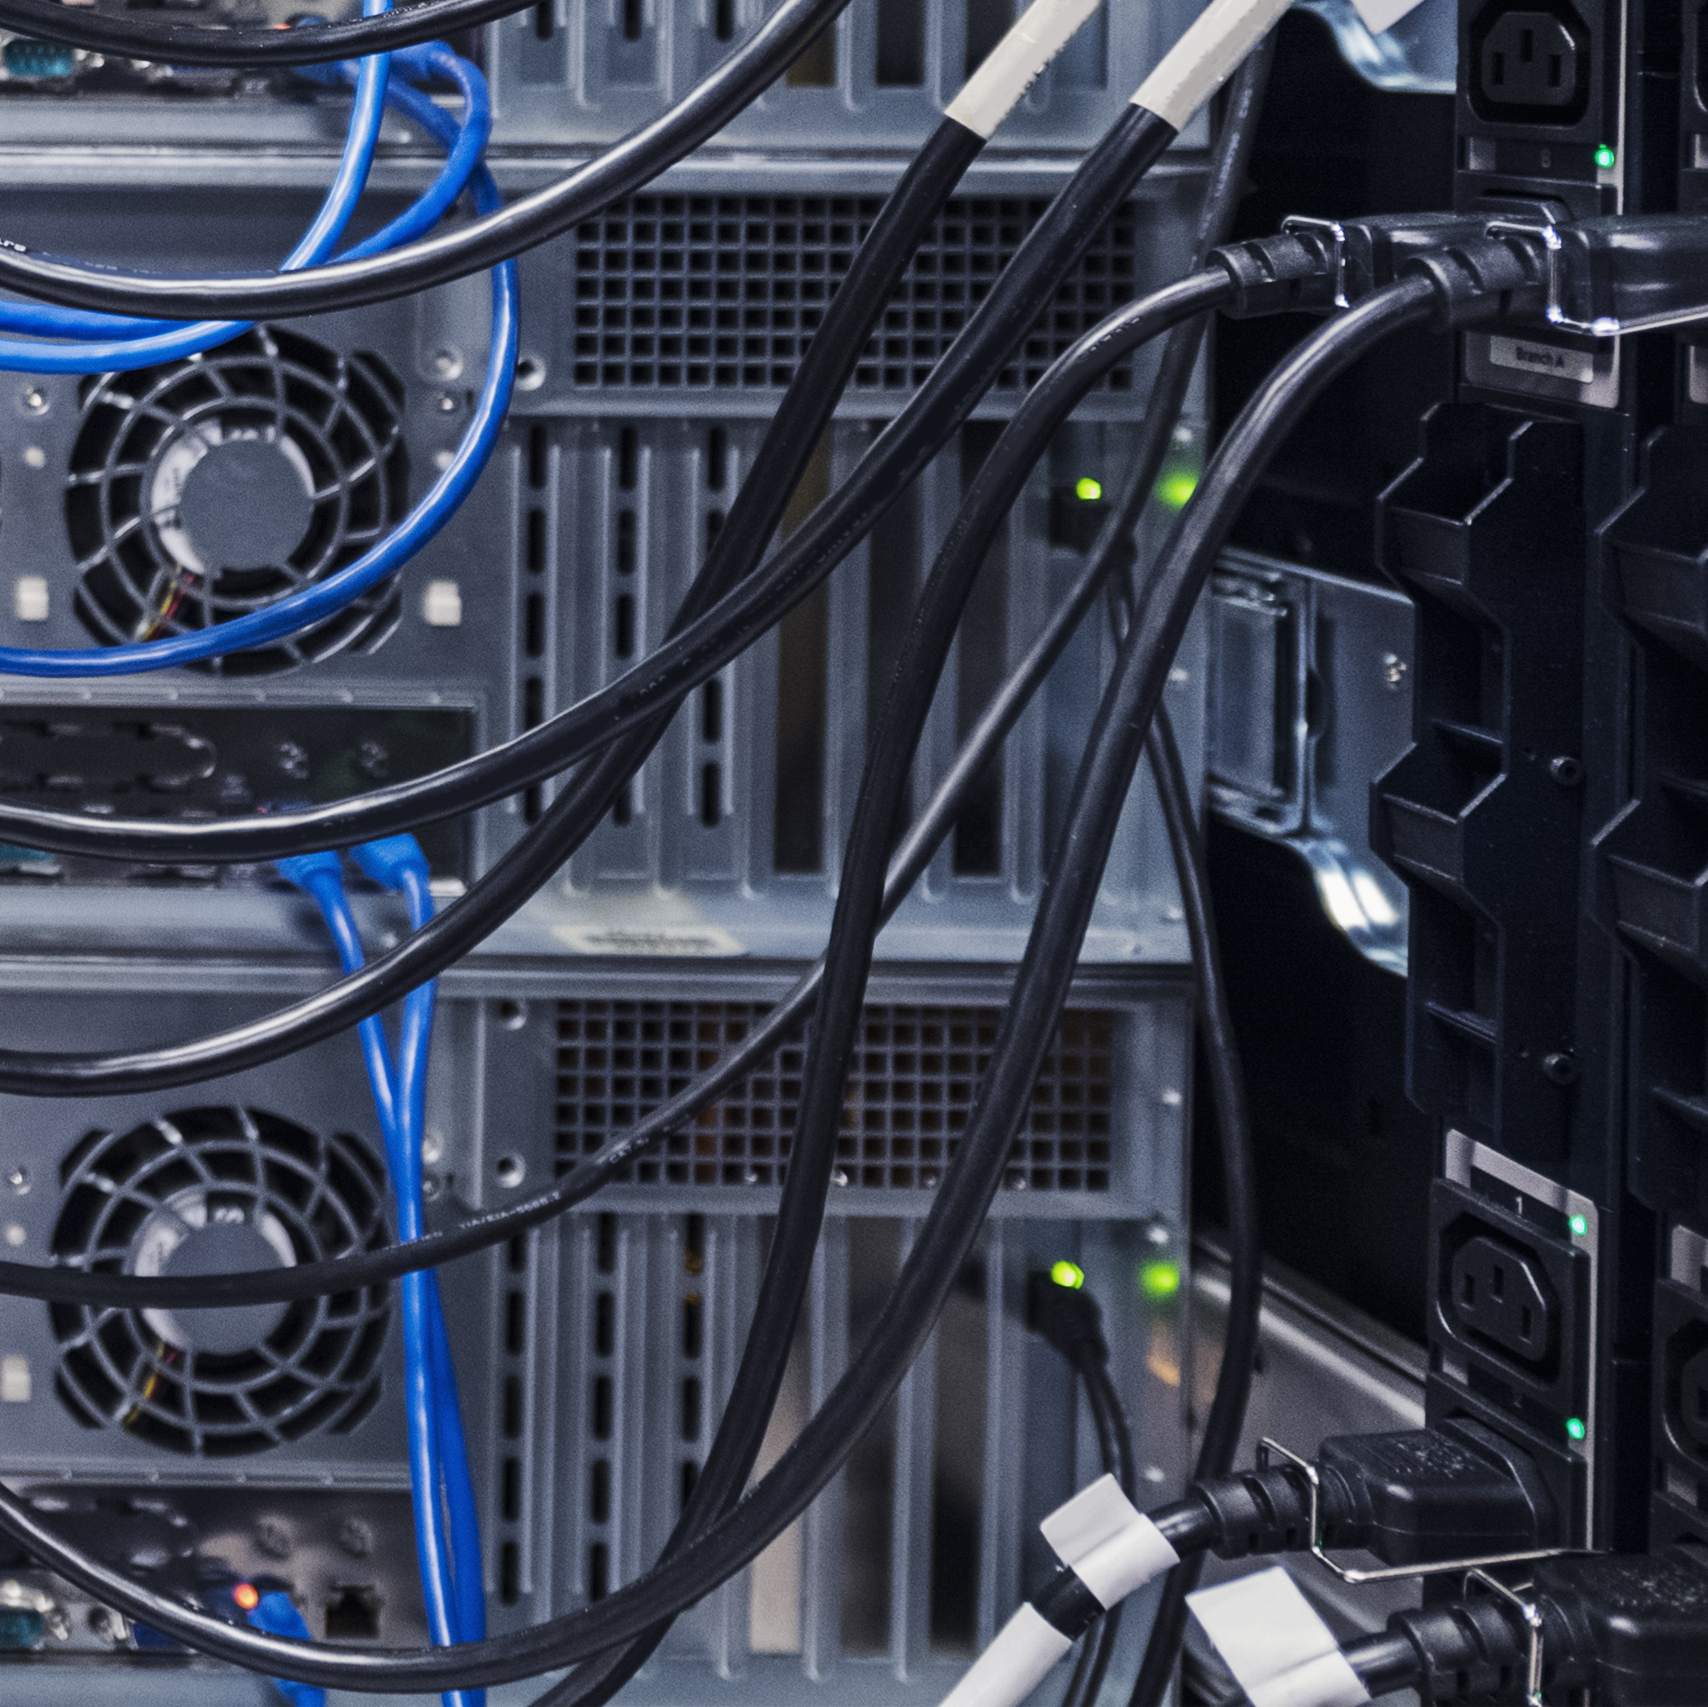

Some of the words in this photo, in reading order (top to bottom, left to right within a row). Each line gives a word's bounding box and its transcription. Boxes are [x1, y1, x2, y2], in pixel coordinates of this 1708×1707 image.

[1514, 346, 1554, 367] Branch
[1555, 353, 1566, 370] A
[1515, 1195, 1524, 1218] 1
